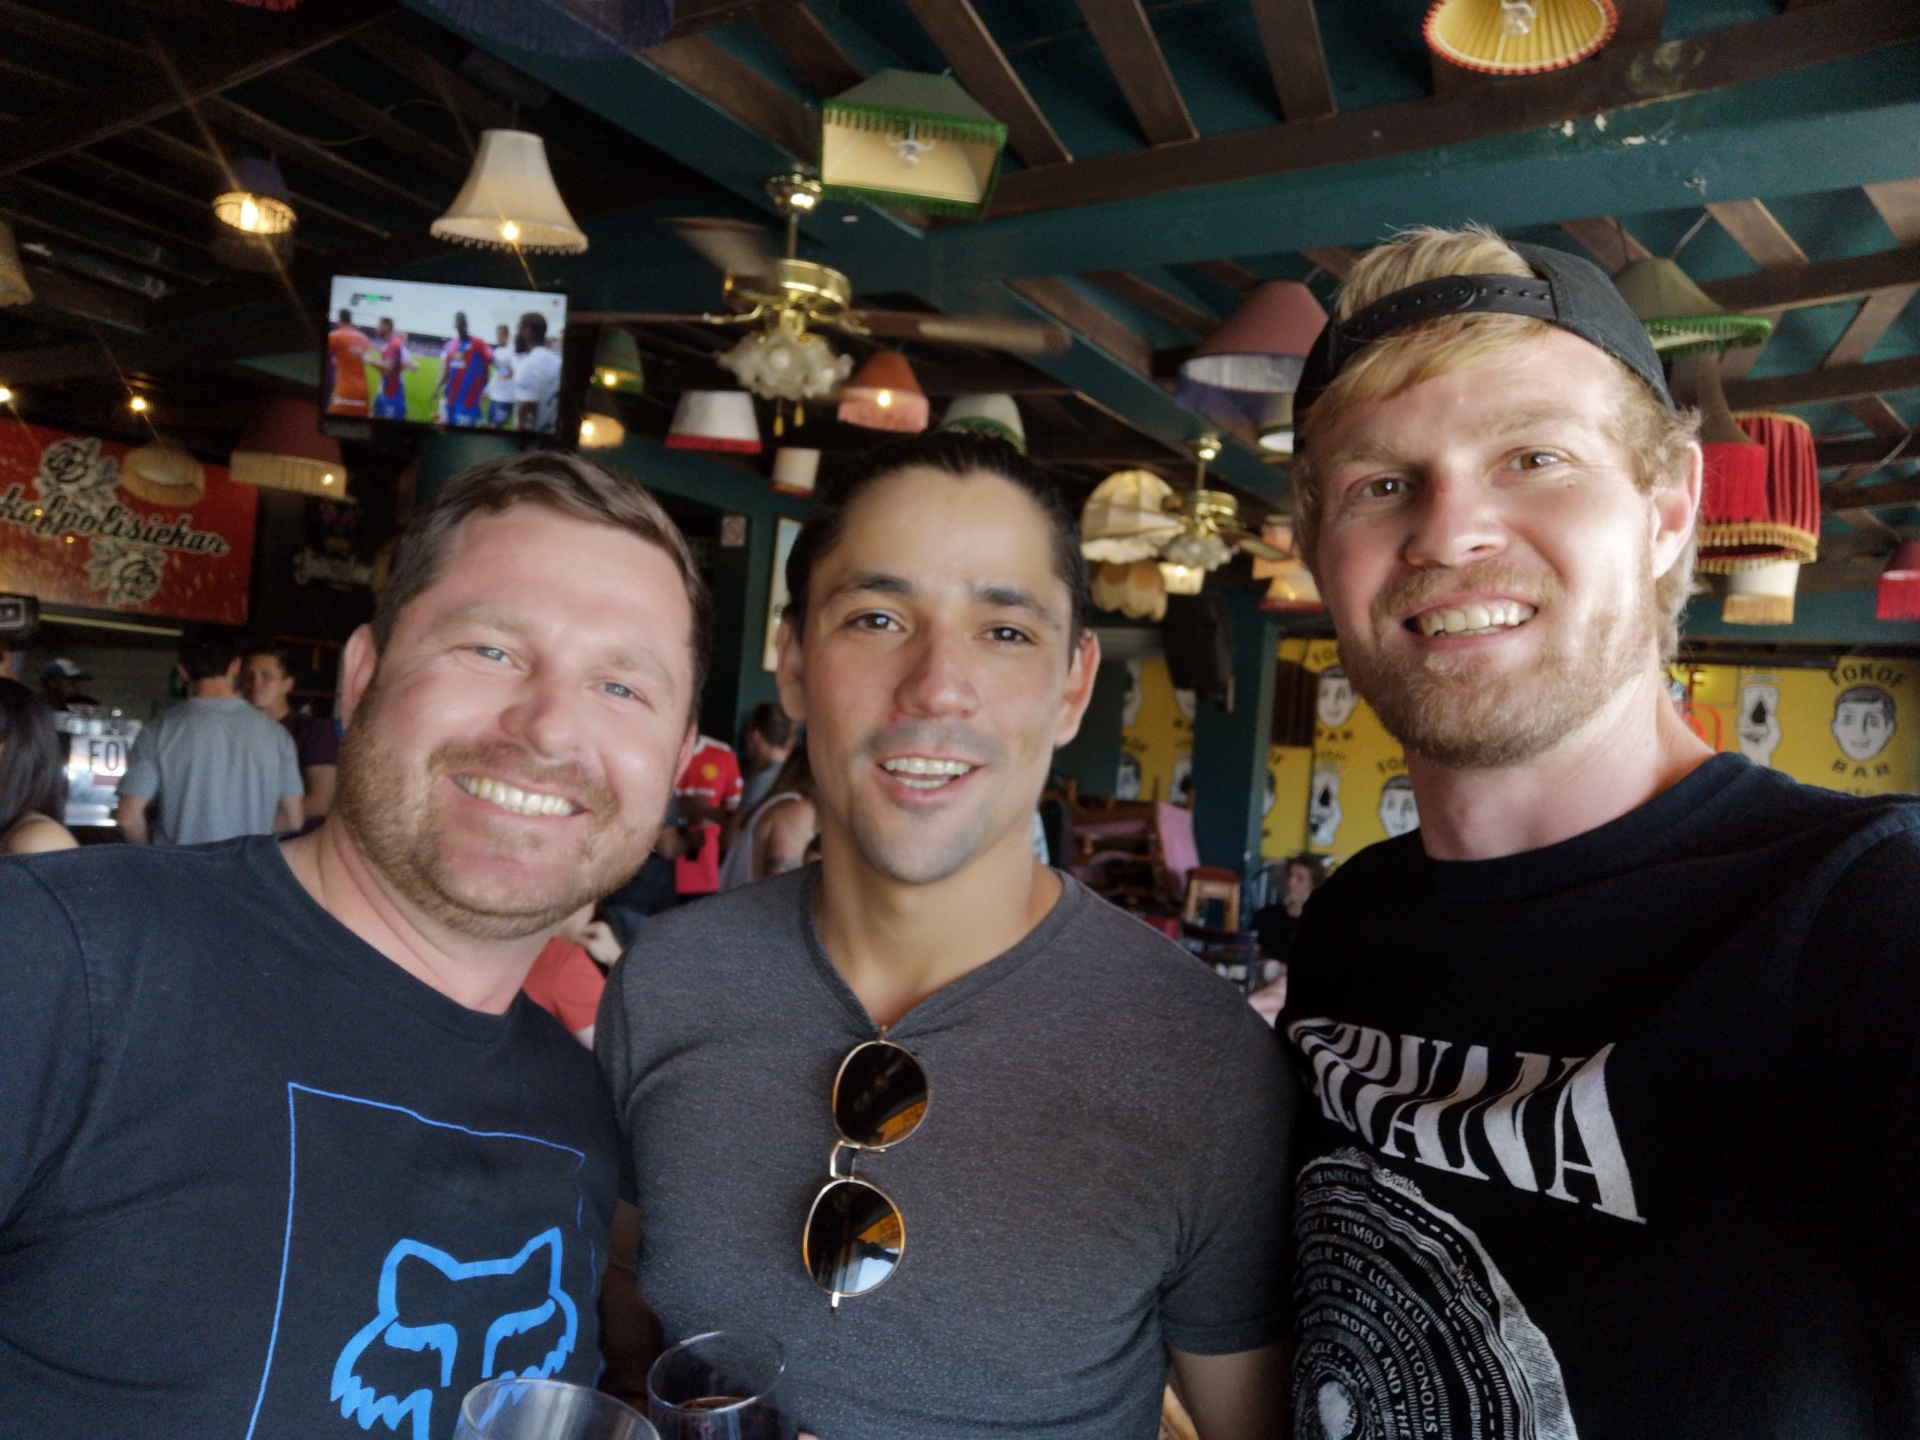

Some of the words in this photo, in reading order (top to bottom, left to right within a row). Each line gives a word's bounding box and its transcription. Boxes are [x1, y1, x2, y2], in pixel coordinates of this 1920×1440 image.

[88, 740, 128, 772] FO
[1340, 1219, 1385, 1250] LIMBO
[1343, 1252, 1365, 1274] THE
[1368, 1268, 1431, 1334] LUSTFUL
[1355, 1287, 1379, 1313] THE
[1382, 1311, 1439, 1434] GLUTTONOUS
[1380, 1356, 1403, 1394] AND
